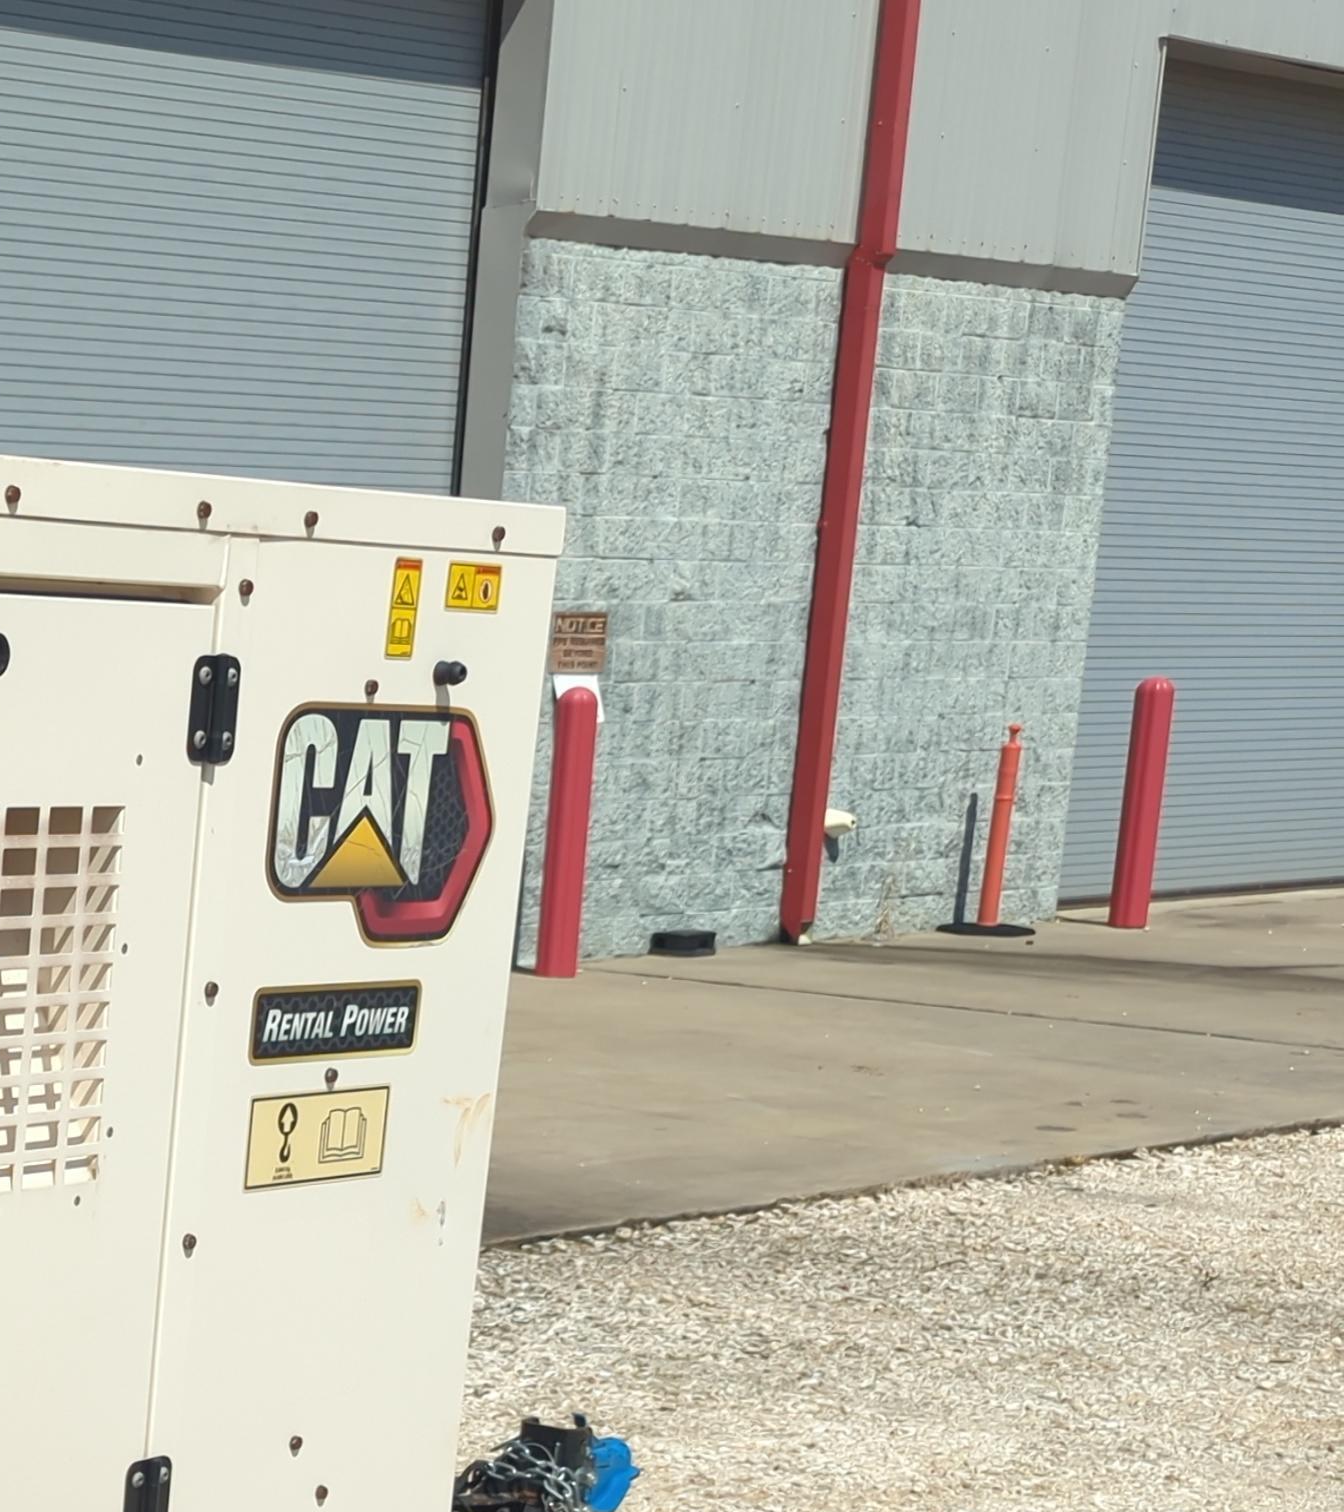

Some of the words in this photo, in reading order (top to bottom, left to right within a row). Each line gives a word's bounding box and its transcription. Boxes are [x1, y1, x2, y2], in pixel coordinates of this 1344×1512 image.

[274, 713, 451, 888] CAT
[262, 1008, 335, 1043] RENTAL
[340, 1004, 410, 1037] POWER
